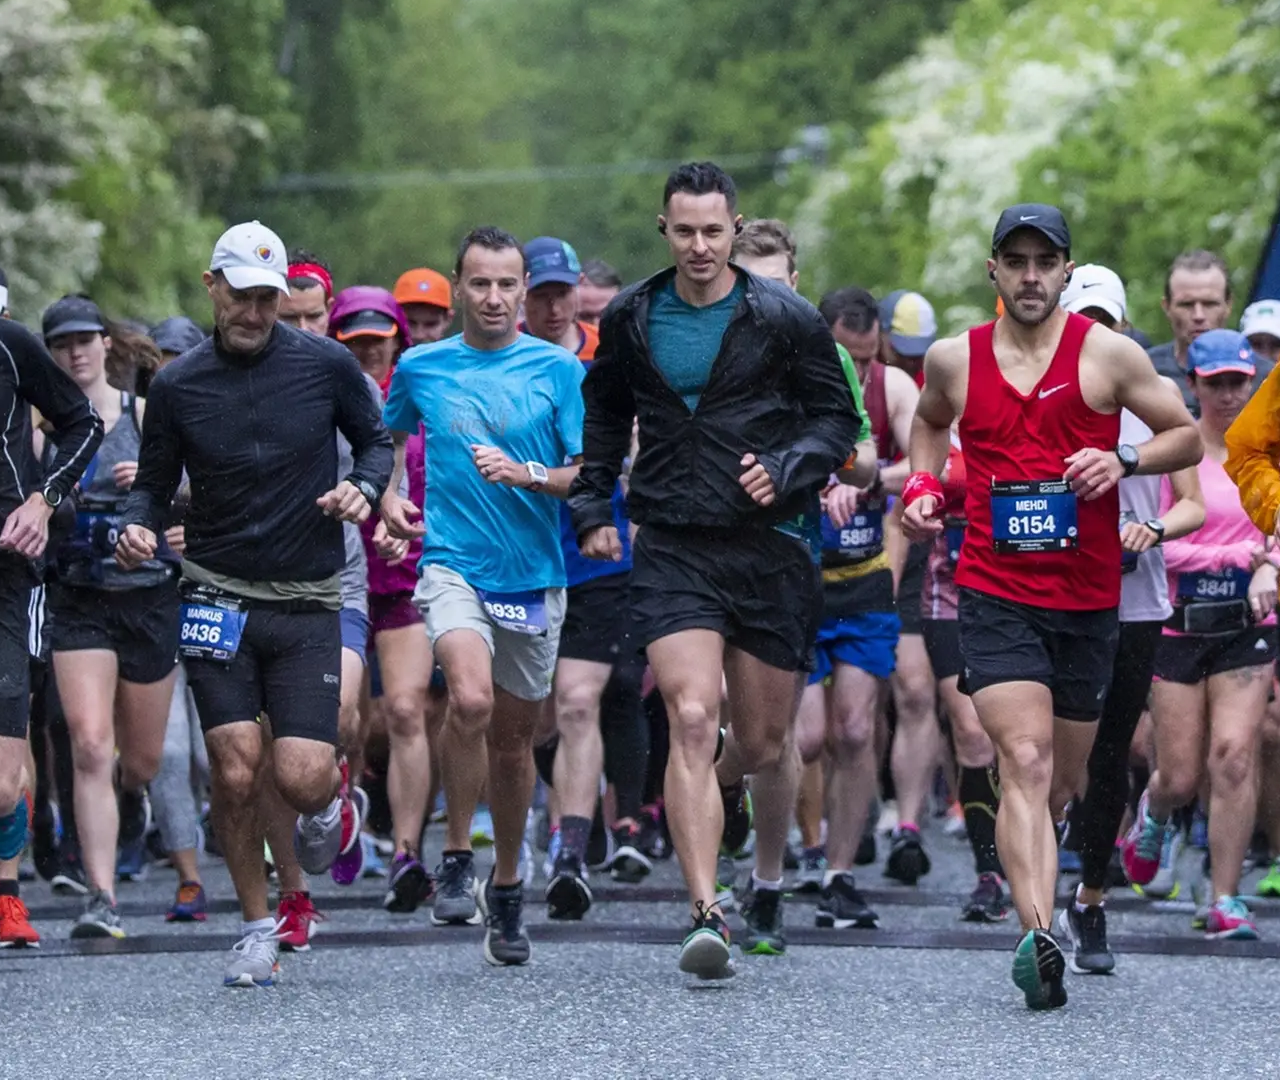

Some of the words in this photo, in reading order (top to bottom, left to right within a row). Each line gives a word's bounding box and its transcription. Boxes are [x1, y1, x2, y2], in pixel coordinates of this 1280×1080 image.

[1015, 499, 1048, 512] MEHDI
[1008, 514, 1056, 535] 8154
[1196, 578, 1237, 597] 3841
[186, 607, 224, 624] MARKUS
[181, 622, 222, 644] 8436
